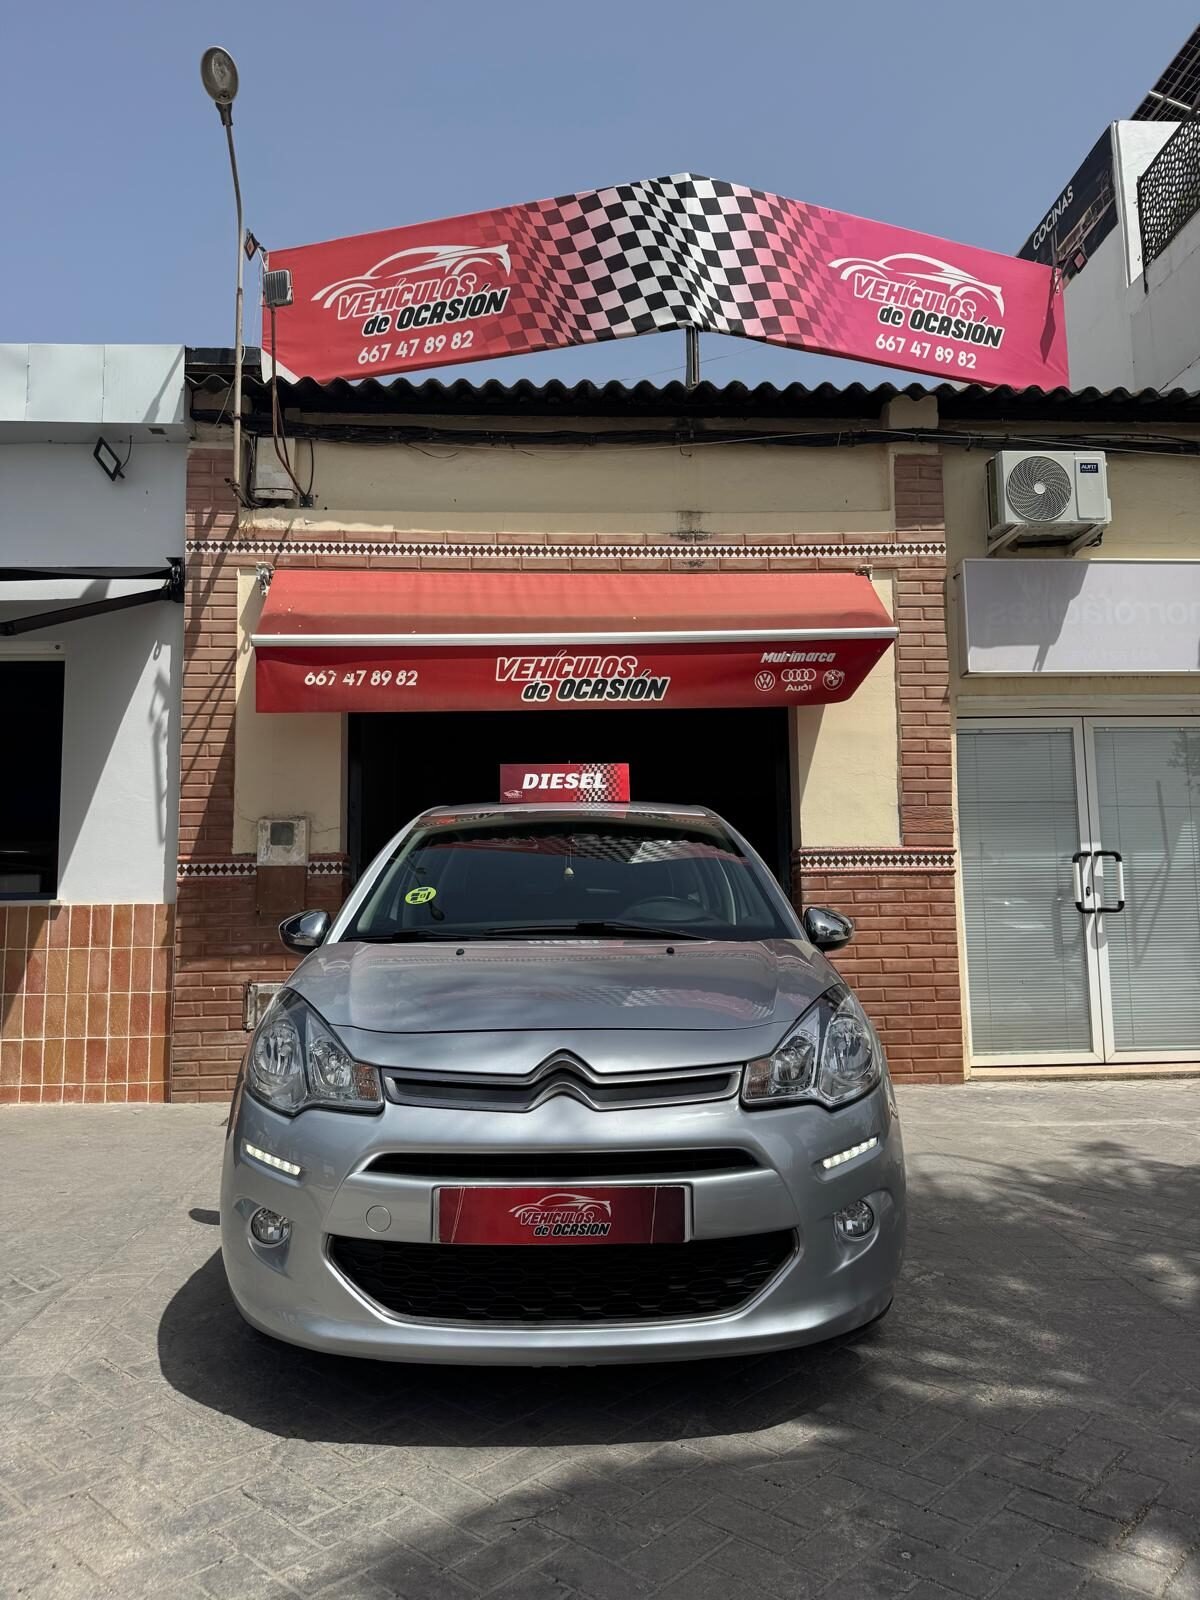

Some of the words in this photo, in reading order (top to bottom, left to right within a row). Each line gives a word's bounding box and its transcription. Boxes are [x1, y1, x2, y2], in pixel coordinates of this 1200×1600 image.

[1033, 185, 1074, 250] COCINAS
[338, 273, 477, 320] VEHÍCULOS
[362, 312, 392, 337] de
[395, 282, 511, 332] OCASIÓN
[854, 272, 977, 320] VEHÍCULOS
[877, 306, 905, 326] de
[909, 308, 1005, 349] OCASIÓN
[358, 343, 392, 365] 667
[395, 338, 420, 358] 47
[424, 334, 446, 354] 89
[451, 330, 474, 350] 82
[875, 333, 905, 353] 667
[910, 341, 931, 358] 47
[935, 346, 954, 364] 89
[958, 352, 977, 369] 82
[304, 670, 337, 686] 667
[342, 670, 367, 686] 47
[370, 670, 393, 686] 89
[396, 670, 418, 686] 82
[496, 650, 638, 682] VEHÍCULOS
[520, 680, 551, 702] de
[557, 670, 671, 702] OCASIÓN
[785, 684, 812, 692] Audi
[522, 773, 607, 789] DIESEL
[534, 1224, 550, 1236] de
